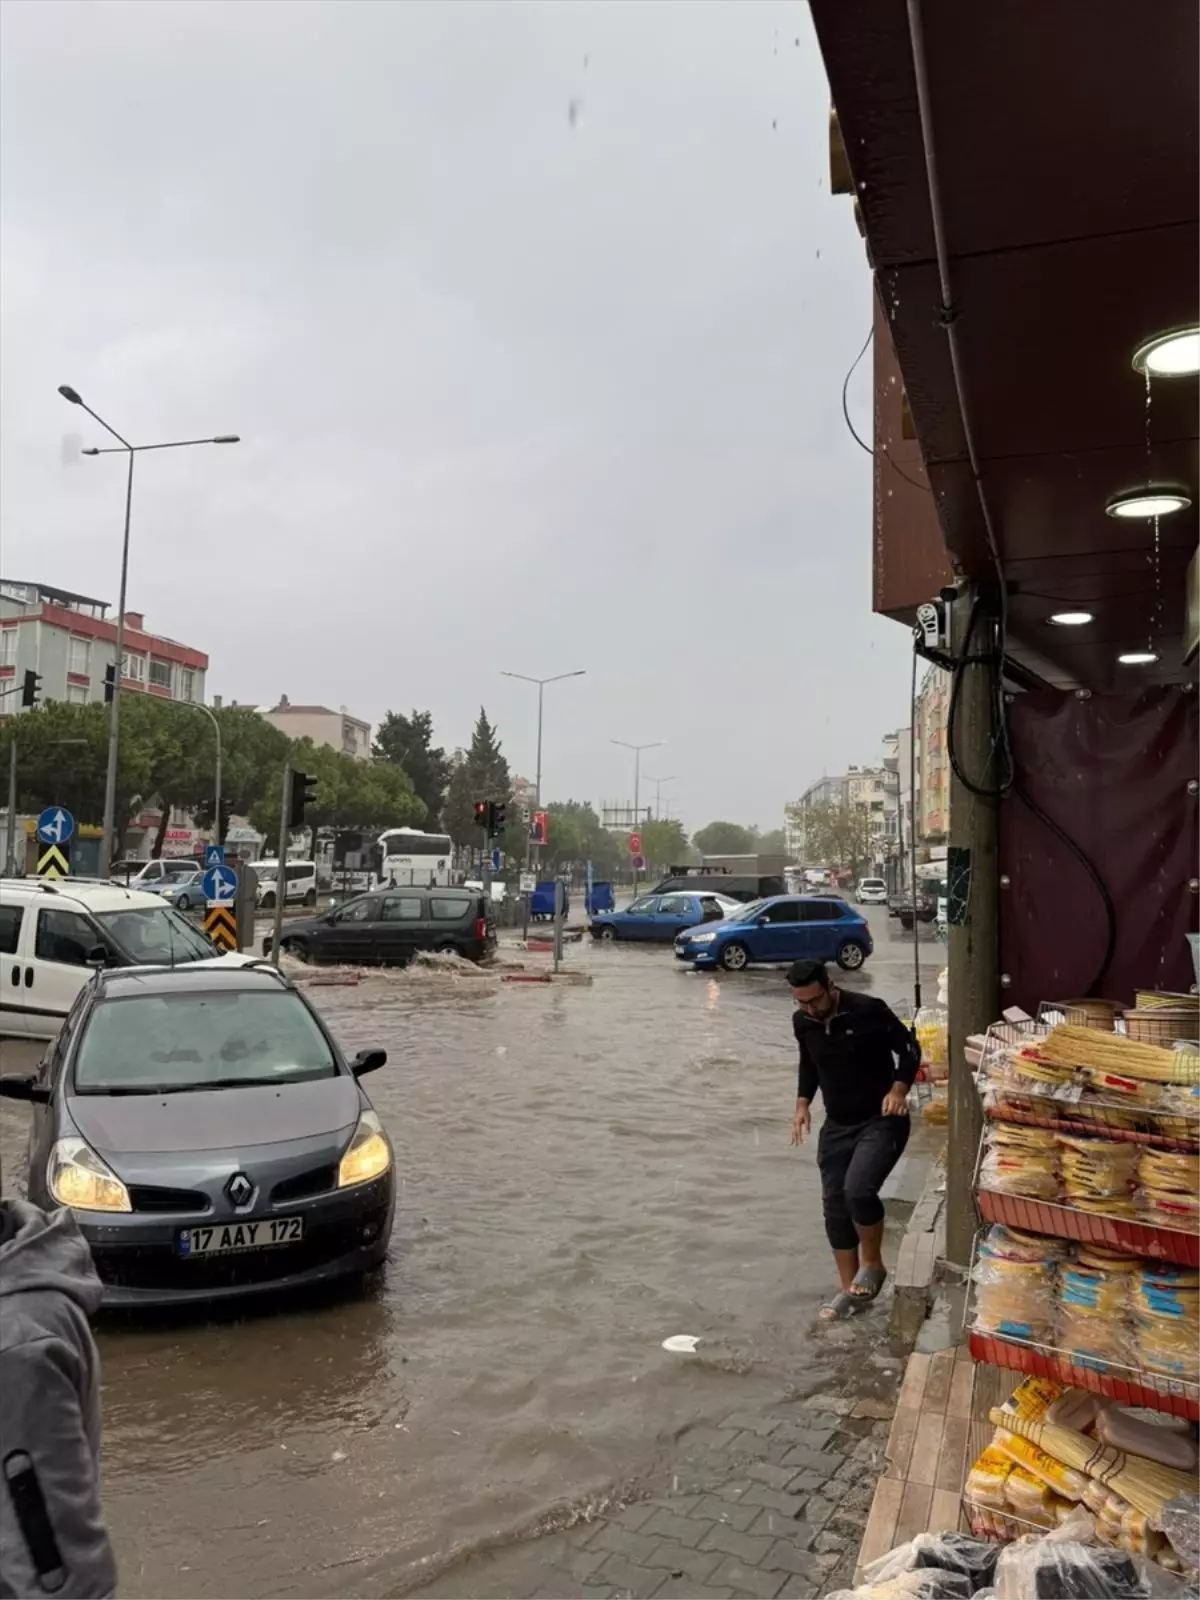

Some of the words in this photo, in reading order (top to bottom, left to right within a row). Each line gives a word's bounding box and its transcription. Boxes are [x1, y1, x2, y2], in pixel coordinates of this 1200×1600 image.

[193, 1229, 214, 1250] 17
[220, 1224, 260, 1248] AAY
[270, 1219, 301, 1241] 172
